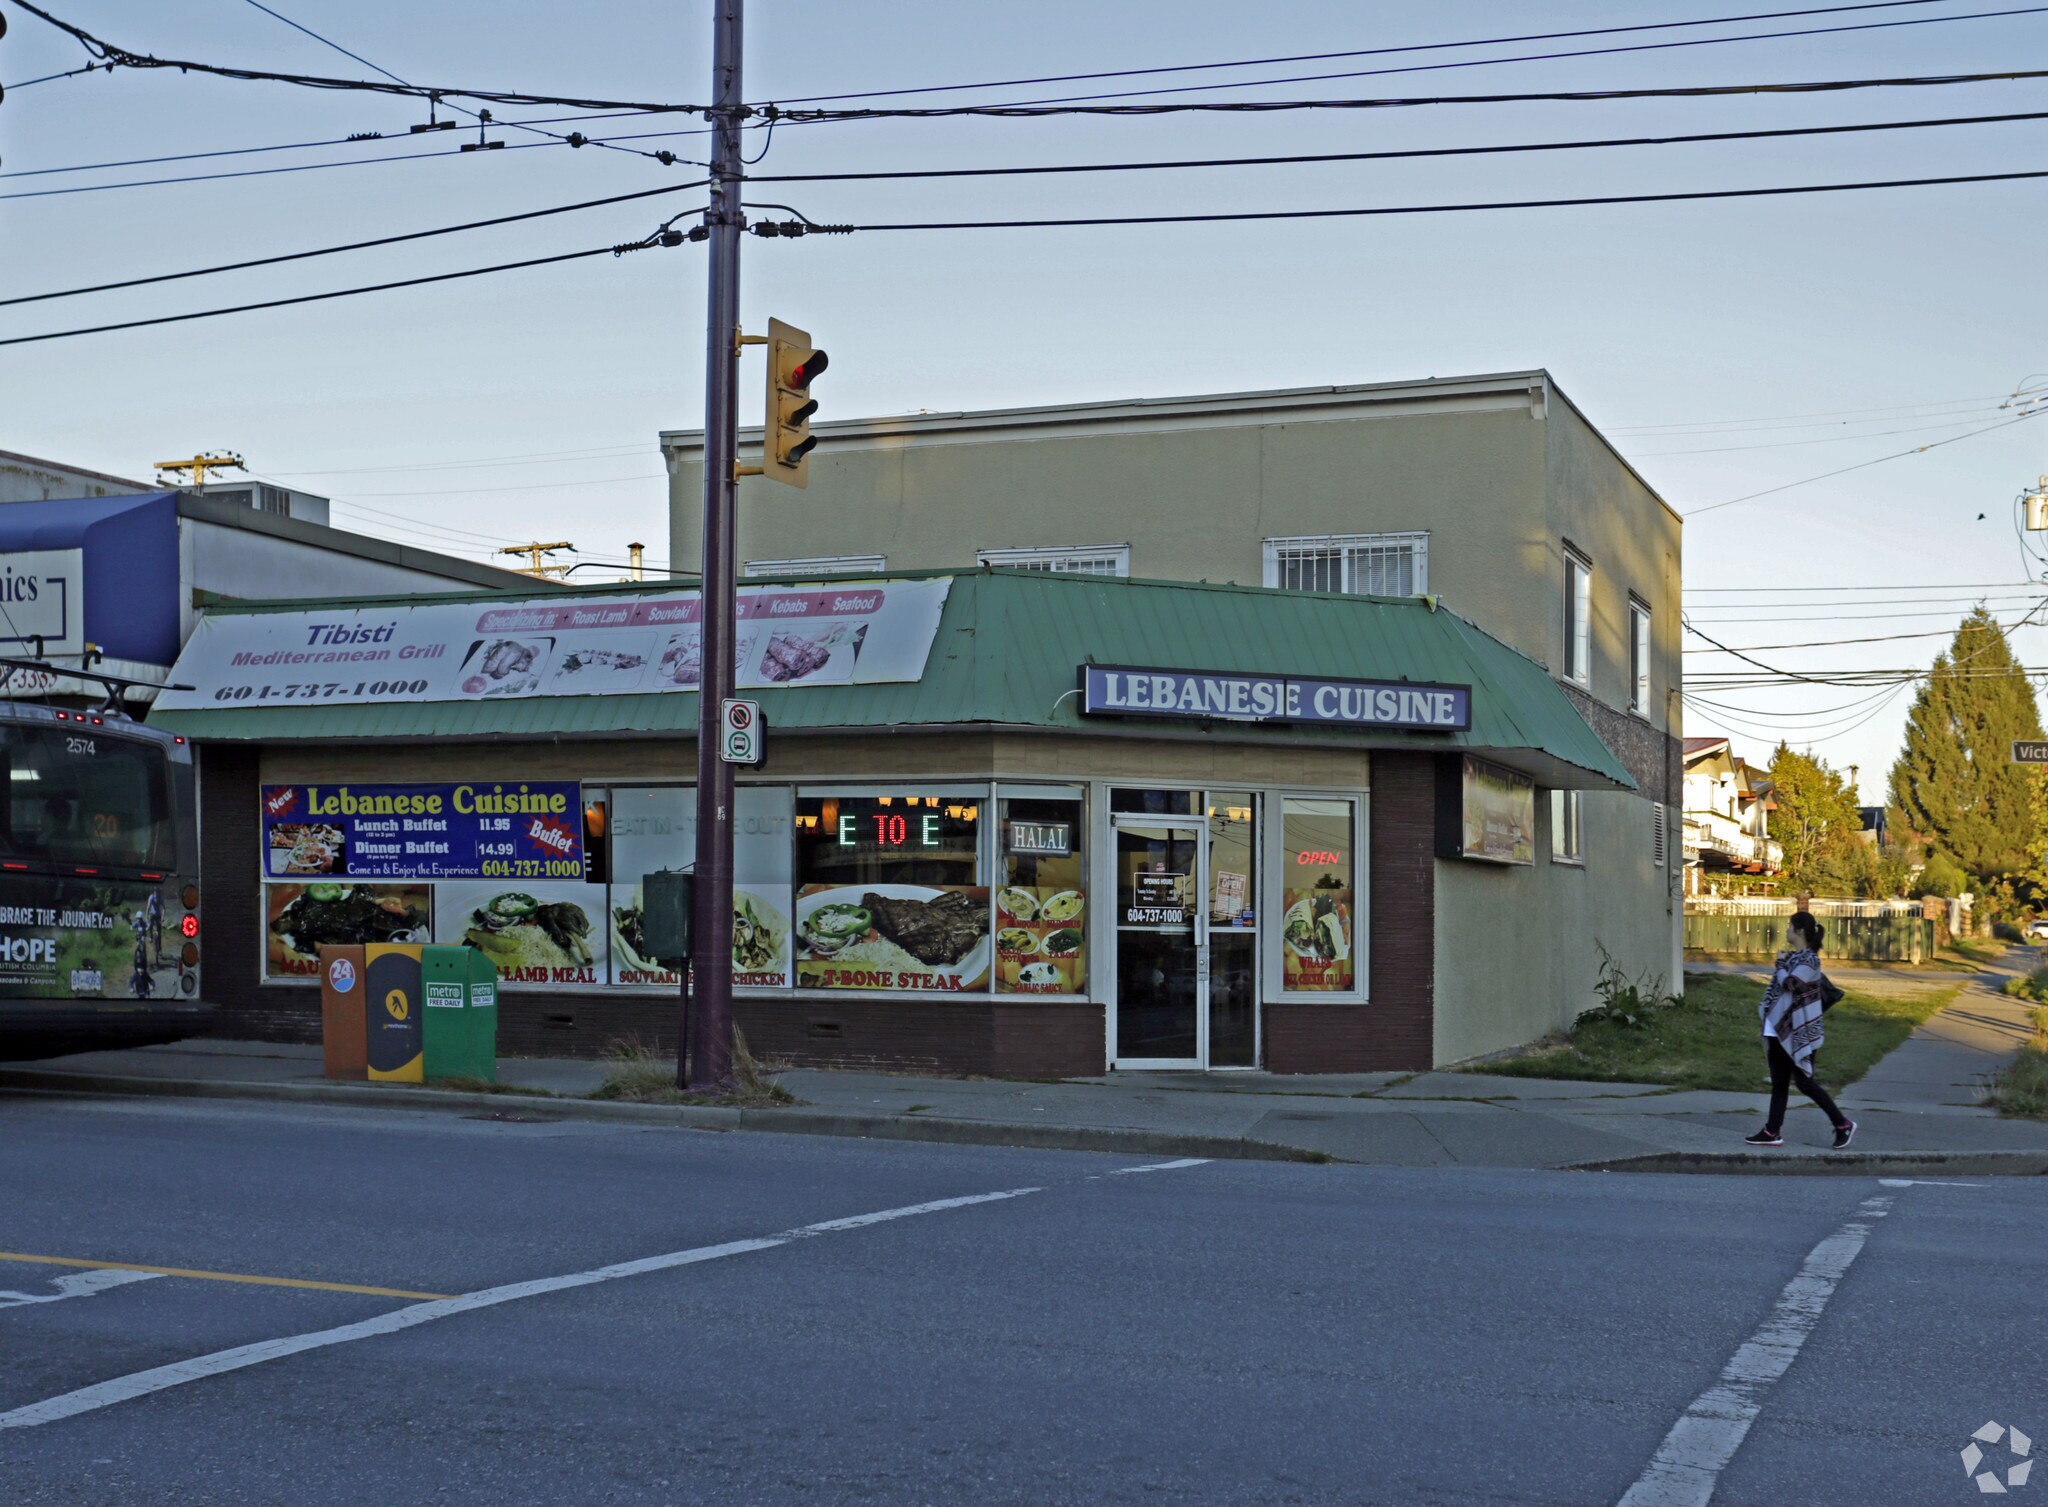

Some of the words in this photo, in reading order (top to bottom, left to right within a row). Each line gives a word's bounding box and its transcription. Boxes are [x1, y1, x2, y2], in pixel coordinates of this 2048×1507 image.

[770, 599, 808, 614] Kebabs
[832, 596, 875, 611] Seafood
[484, 608, 541, 628] Specializing
[571, 610, 598, 624] Roast
[602, 608, 628, 623] Lamb
[648, 606, 690, 621] Souvlaki
[307, 622, 397, 646] Tibisti
[230, 648, 391, 667] Mediterranean
[398, 643, 447, 660] Grill
[1105, 673, 1301, 716] LEBANESE
[1313, 685, 1455, 725] CUISINE
[66, 737, 96, 756] 2574
[2020, 745, 2048, 759] Vict
[268, 788, 293, 813] New
[307, 786, 442, 816] Lebanese
[452, 784, 567, 815] Cuisine
[354, 818, 399, 831] Lunch
[403, 818, 447, 831] Buffet
[479, 818, 511, 831] 11.95
[840, 816, 855, 845] E
[873, 815, 906, 845] TO
[923, 815, 939, 845] E
[94, 824, 118, 848] 20
[529, 819, 573, 853] Buffet
[1014, 826, 1067, 849] HALAL
[355, 841, 400, 854] Dinner
[405, 840, 449, 854] Buffet
[478, 843, 514, 856] 14.99
[1297, 851, 1340, 865] OPEN
[347, 862, 371, 875] Come
[373, 864, 381, 875] in
[383, 862, 390, 874] &
[393, 862, 416, 879] Enjoy
[418, 862, 430, 875] the
[432, 862, 479, 878] Experience
[481, 860, 581, 876] 604-737-1000
[1221, 879, 1241, 890] OPEN
[36, 909, 56, 926] THE
[59, 910, 113, 929] JOURNEY.CA
[1127, 908, 1183, 923] 604-737-1000
[22, 963, 56, 971] COLUMBIA
[332, 963, 351, 979] 24
[504, 966, 548, 983] LAMB
[552, 967, 597, 983] MEAL
[30, 977, 56, 986] Canyons
[619, 970, 678, 984] SOUVLAKI
[731, 973, 786, 986] CHICKEN
[825, 970, 900, 988] T-BONE
[898, 972, 963, 990] STEAK
[429, 986, 461, 998] metro
[472, 985, 493, 996] metro
[1041, 983, 1063, 993] SAUCE
[429, 998, 443, 1006] FREE
[444, 999, 461, 1007] DAILY
